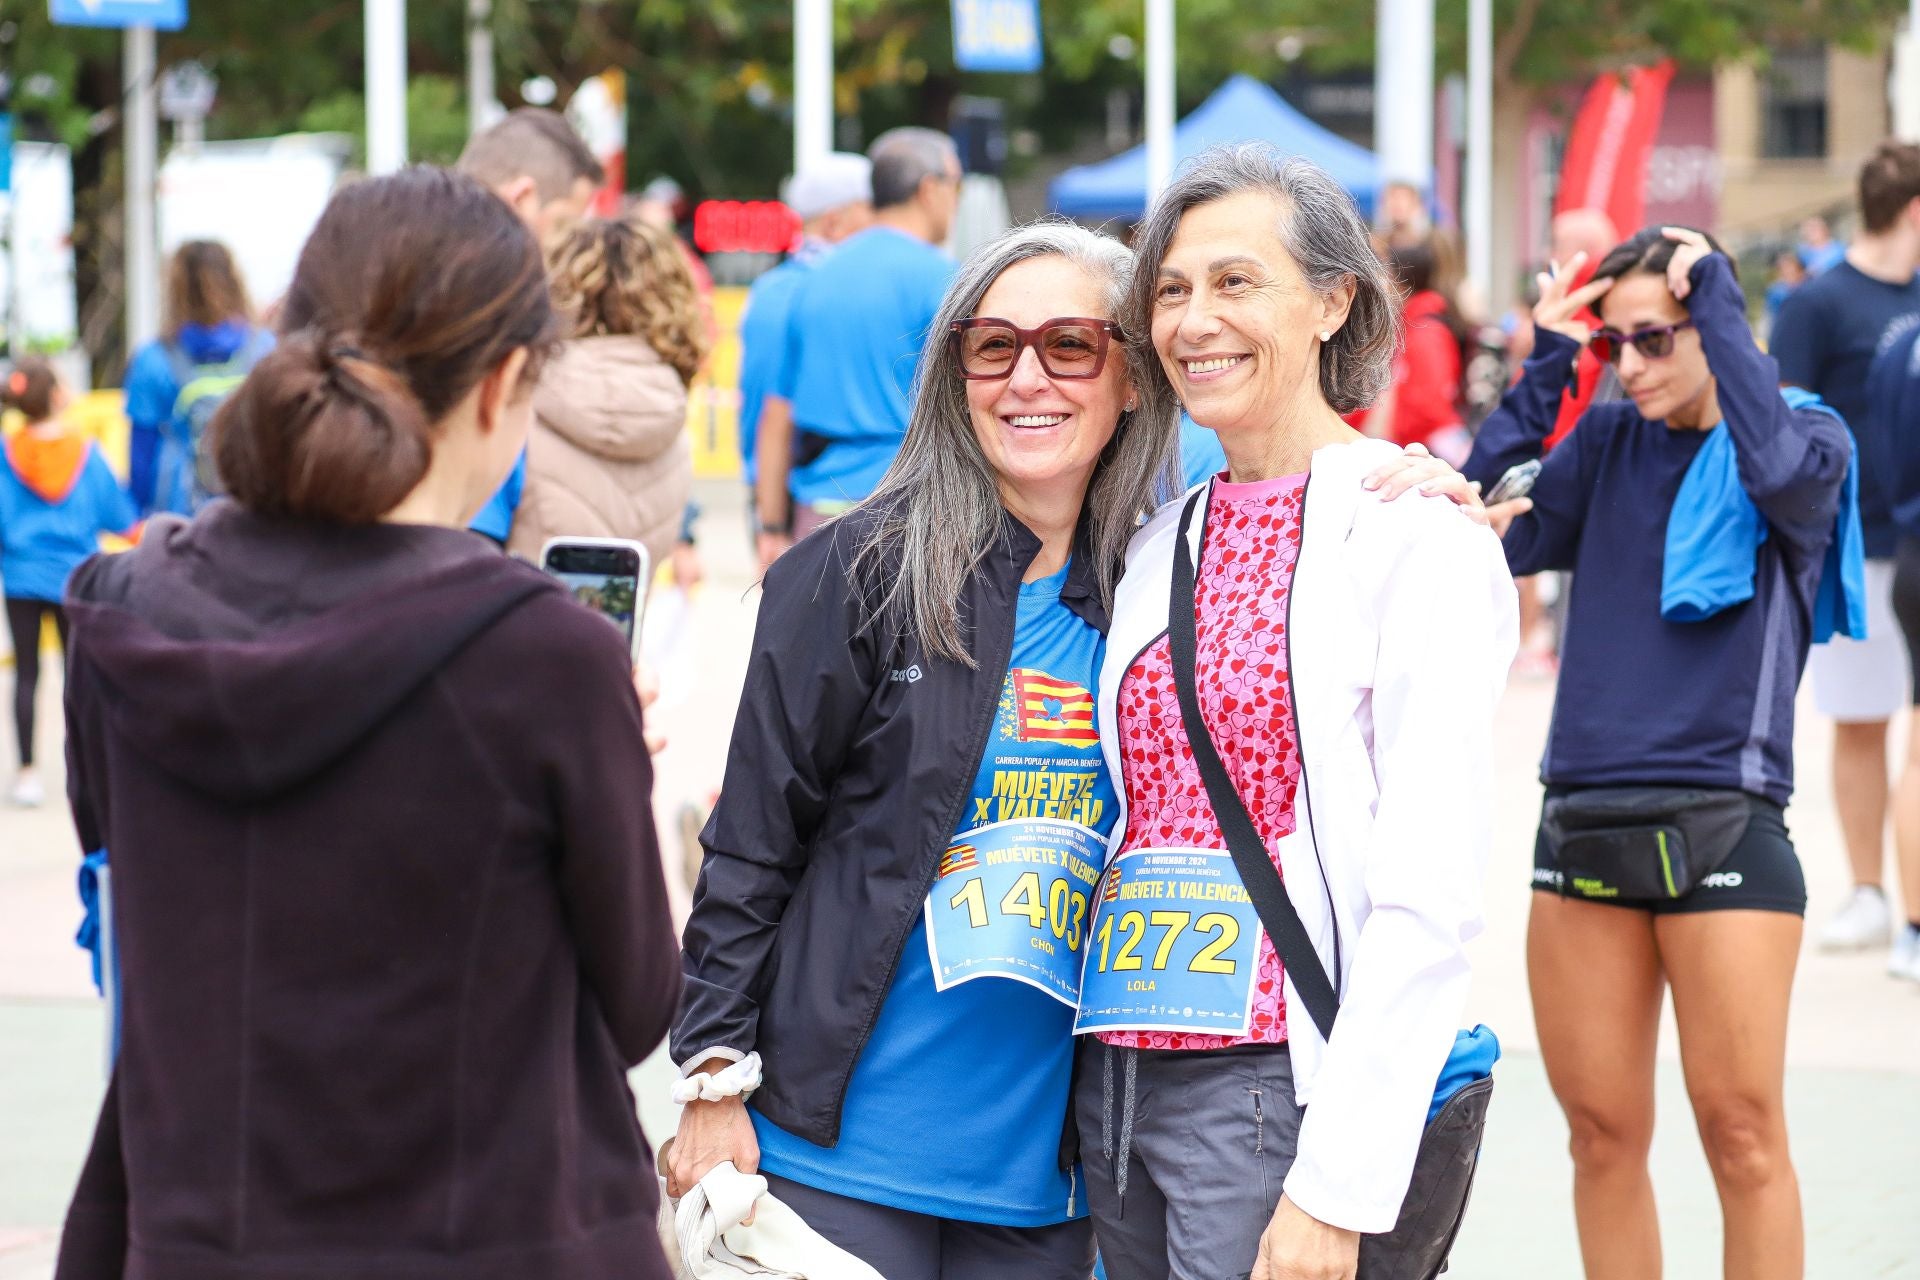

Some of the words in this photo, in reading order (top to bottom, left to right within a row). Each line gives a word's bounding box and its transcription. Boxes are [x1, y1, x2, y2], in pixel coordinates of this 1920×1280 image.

[995, 756, 1023, 765] CARRERA
[1024, 757, 1050, 766] POPULAR
[1051, 758, 1056, 766] Y
[1056, 758, 1079, 767] MARCHA
[992, 766, 1098, 801] MUÉVETE
[971, 798, 993, 822] X
[997, 797, 1103, 827] VALENCIA
[1011, 834, 1037, 842] CARRERA
[1037, 836, 1060, 844] POPULAR
[1024, 825, 1034, 833] 24
[1035, 825, 1074, 838] NOVIEMBRE
[985, 844, 1058, 866] MUÉVETE
[1060, 850, 1069, 868] X
[1144, 857, 1151, 865] 24
[1151, 856, 1188, 865] NOVIEMBRE
[1188, 857, 1207, 866] 2024
[1151, 867, 1170, 875] POPULAR
[1175, 868, 1196, 876] MARCHA
[1196, 867, 1221, 877] BENÉFICA
[1119, 879, 1165, 901] MUÉVETE
[1166, 881, 1177, 899] X
[950, 871, 1087, 952] 1403
[1030, 937, 1055, 957] CHON
[1097, 910, 1240, 975] 1272
[1127, 980, 1156, 992] LOLA
